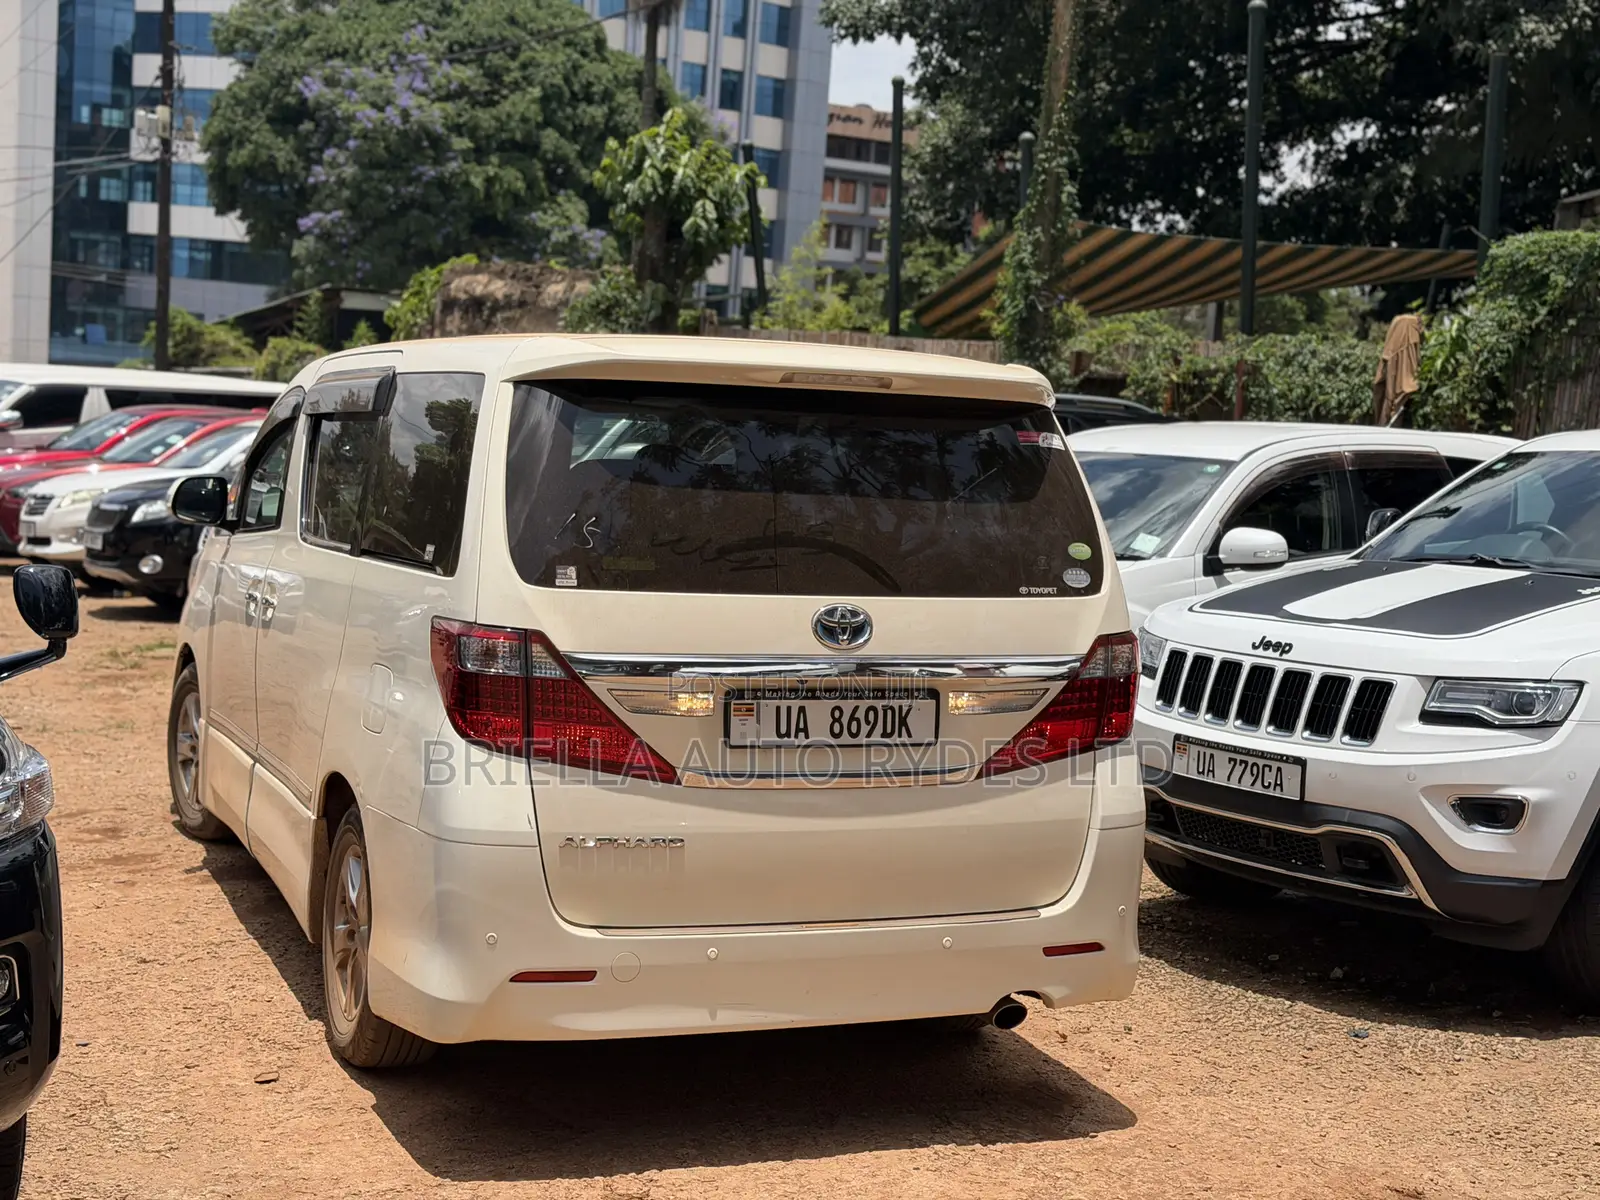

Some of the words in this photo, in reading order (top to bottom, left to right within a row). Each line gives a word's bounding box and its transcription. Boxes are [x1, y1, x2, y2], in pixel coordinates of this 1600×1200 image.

[1028, 587, 1058, 595] TOYOPET
[1251, 635, 1294, 657] Jeep
[774, 704, 810, 740] UA
[828, 703, 914, 740] 869DK
[1196, 749, 1216, 779] UA
[1226, 756, 1285, 793] 779CA
[557, 835, 686, 849] ALPHARD
